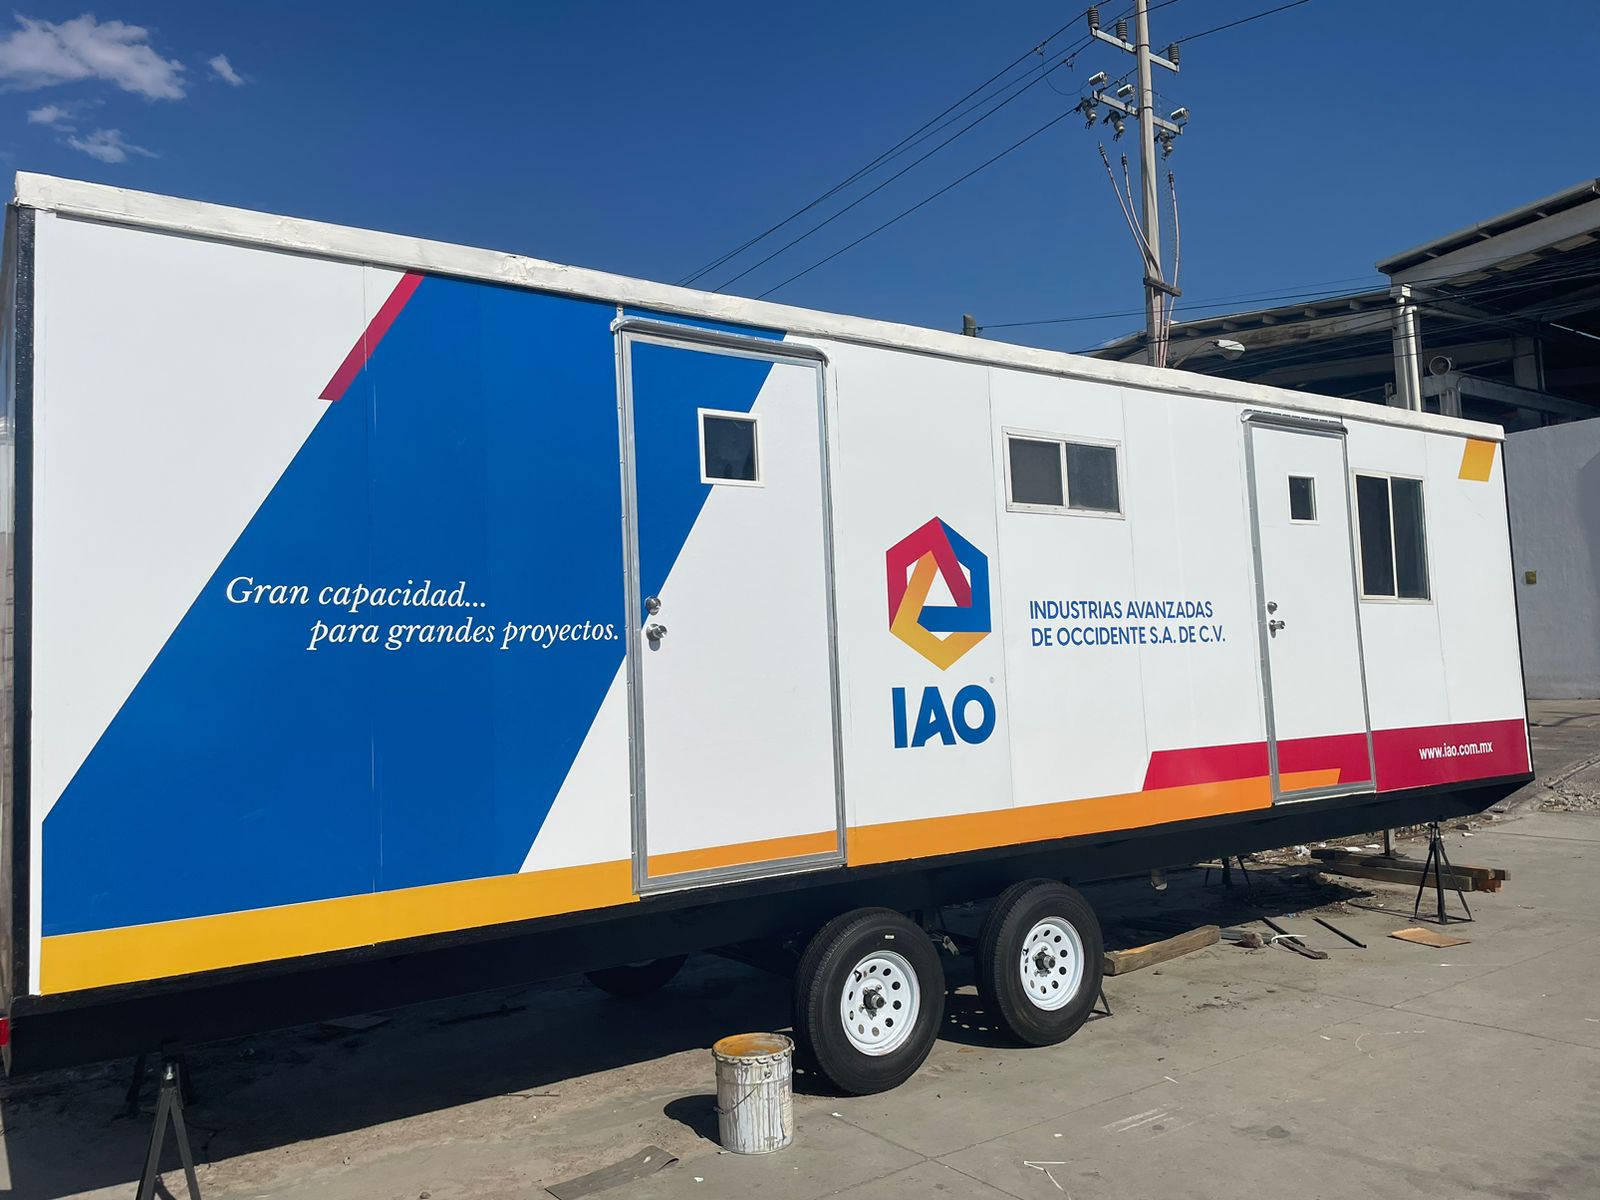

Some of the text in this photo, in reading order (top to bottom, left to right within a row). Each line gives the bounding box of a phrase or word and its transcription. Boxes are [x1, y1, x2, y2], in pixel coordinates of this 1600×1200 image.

[225, 575, 488, 614] Gran capacidad...
[1029, 600, 1214, 620] INDUSTRIAS AVANZADAS
[305, 616, 620, 652] para grandes proyectos.
[1031, 625, 1226, 647] DE OCCIDENTE S.A. DE C.V.
[891, 684, 996, 749] IAO
[1418, 741, 1494, 760] www.iao.com.mx
